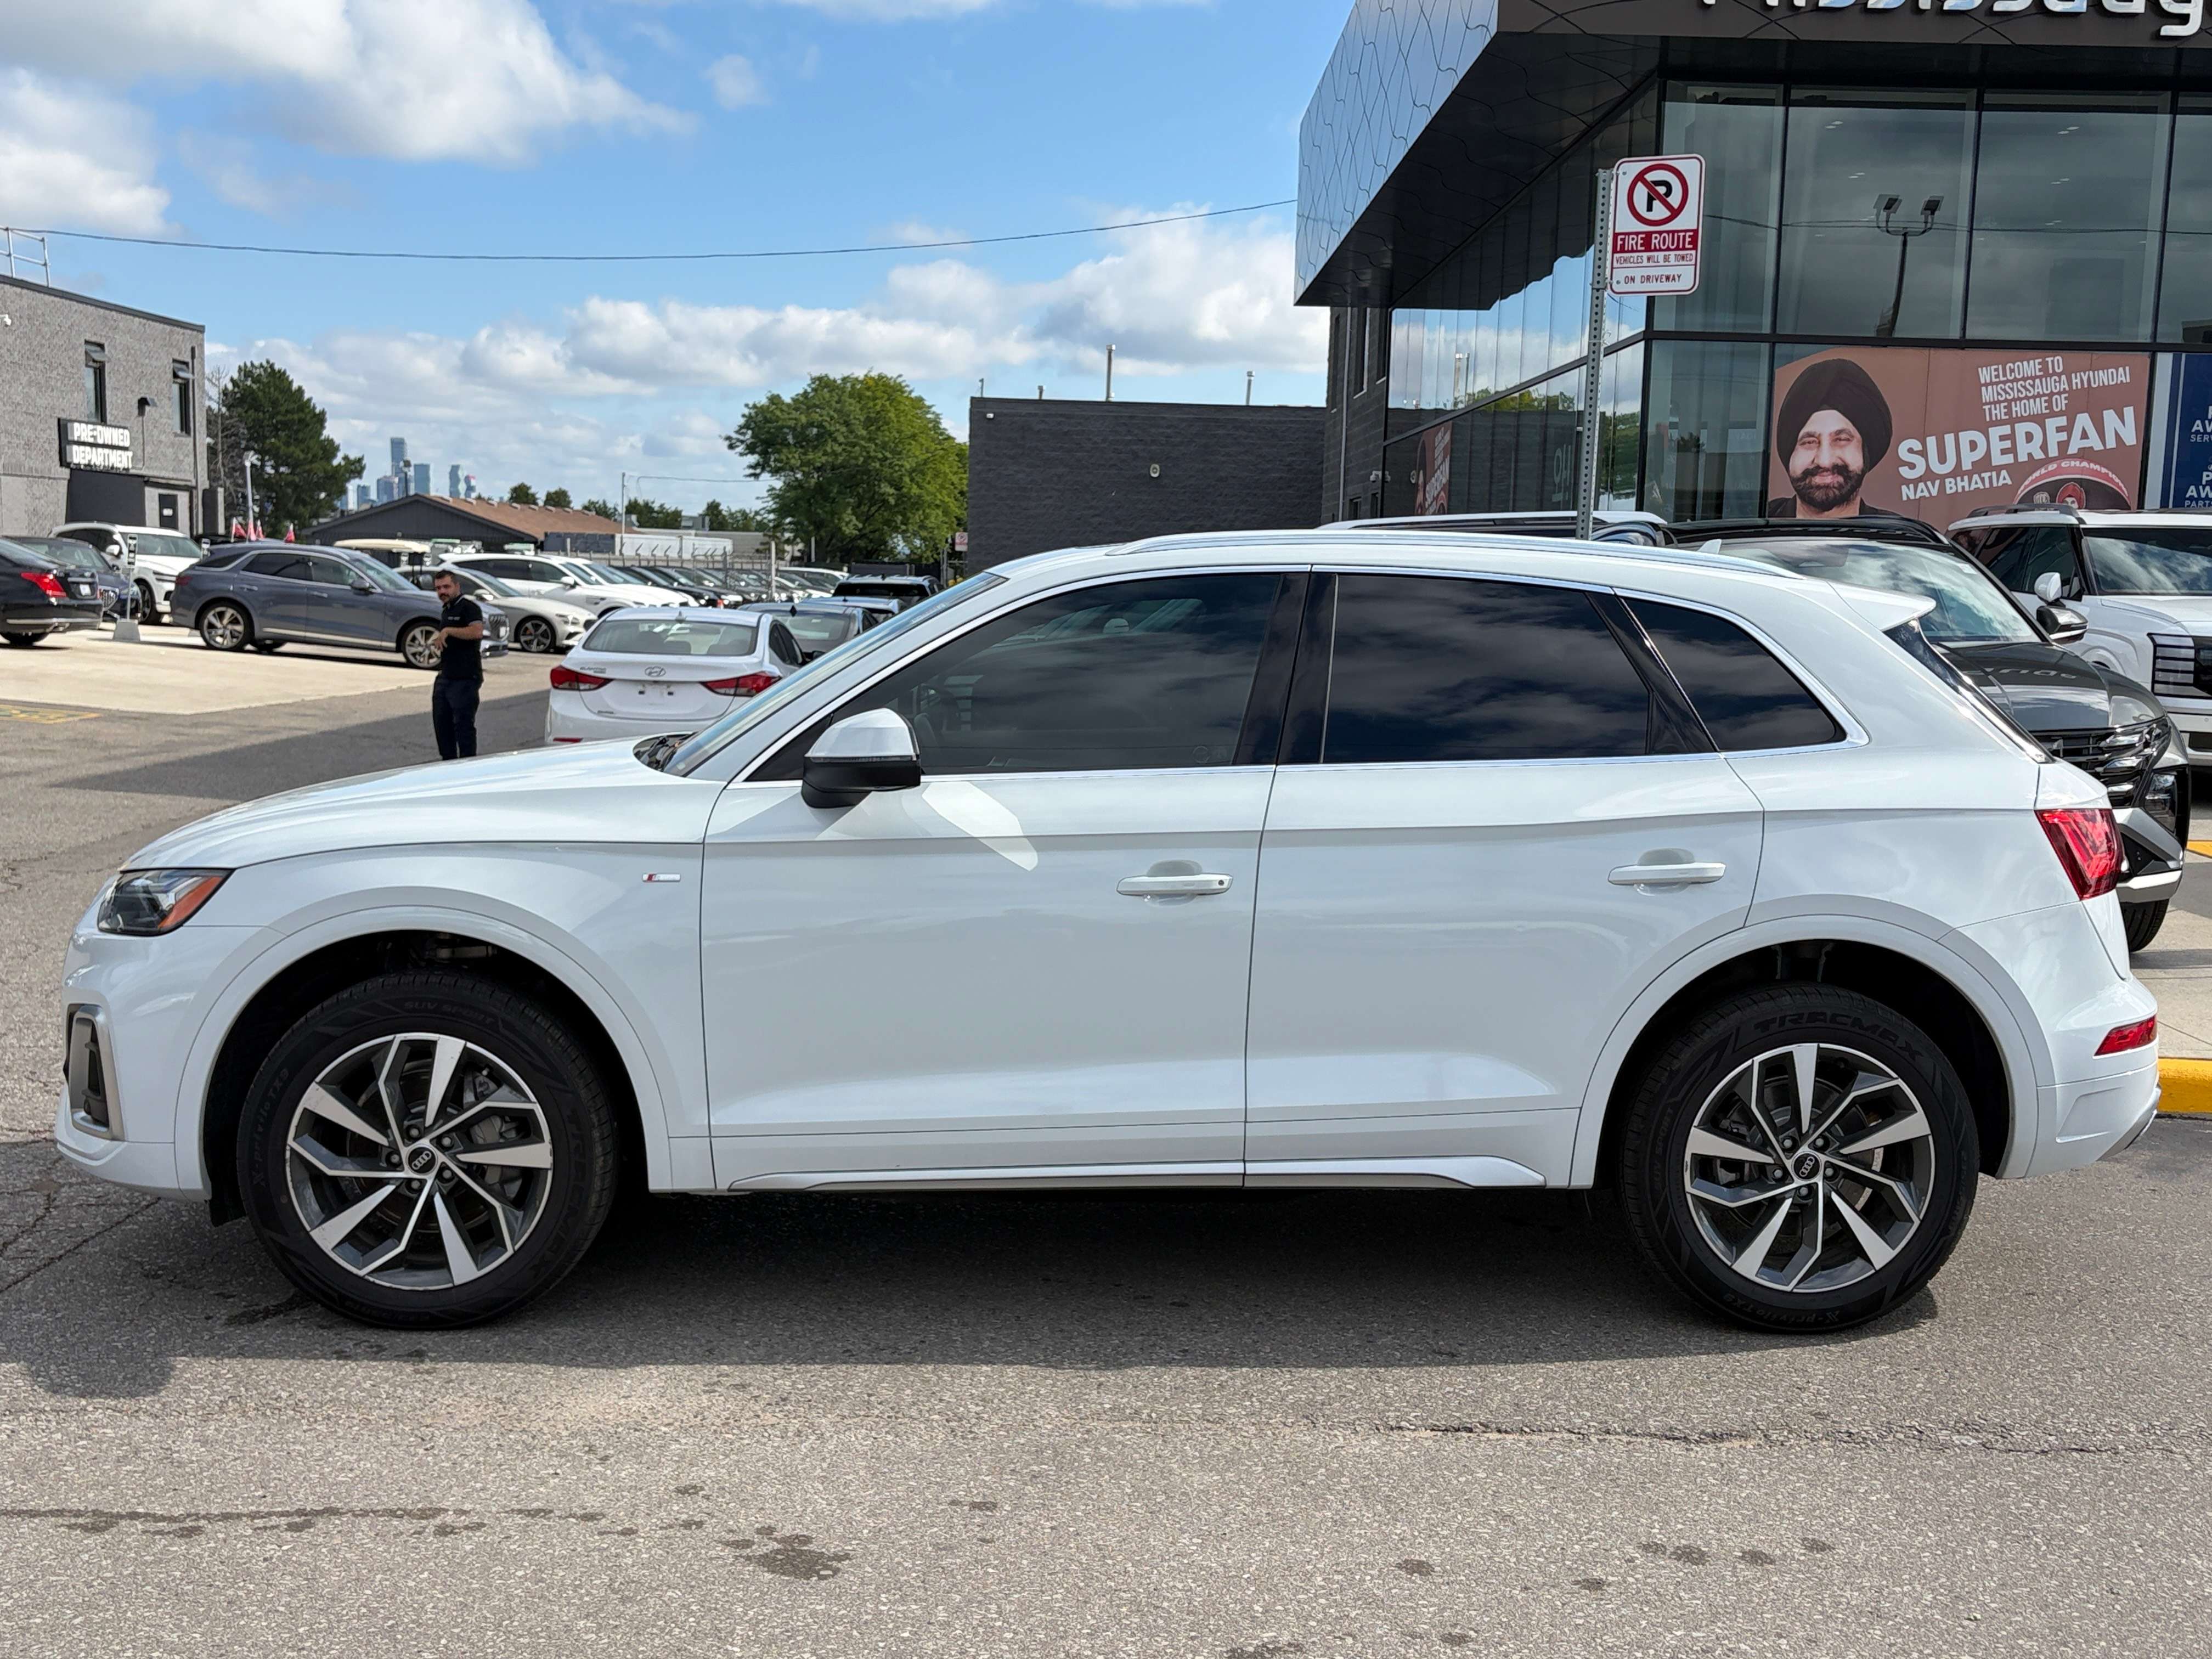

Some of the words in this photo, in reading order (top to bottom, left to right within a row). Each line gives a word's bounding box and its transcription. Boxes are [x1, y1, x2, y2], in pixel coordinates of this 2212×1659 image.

[1617, 234, 1645, 251] FIRE
[1651, 232, 1694, 250] ROUTE
[1616, 255, 1644, 265] VEHICLES
[1646, 255, 1660, 264] WILL
[1663, 254, 1672, 263] BE
[1674, 253, 1694, 262] TOWED
[1624, 275, 1635, 285] ON
[1640, 273, 1682, 284] DRIVEWAY
[1978, 358, 2044, 383] WELCOME
[2045, 356, 2063, 374] TO
[1981, 375, 2069, 403] MISSISSAUGA
[2071, 366, 2131, 390] HYUNDAI
[1983, 402, 2009, 422] THE
[2011, 397, 2050, 418] HOME
[2052, 393, 2069, 412] OF
[73, 422, 130, 448] PRE-OWNED
[1897, 406, 2137, 479] SUPERFAN
[72, 445, 133, 469] DEPARTMENT
[1901, 479, 1940, 501] NAV
[1945, 469, 2012, 494] BHATIA
